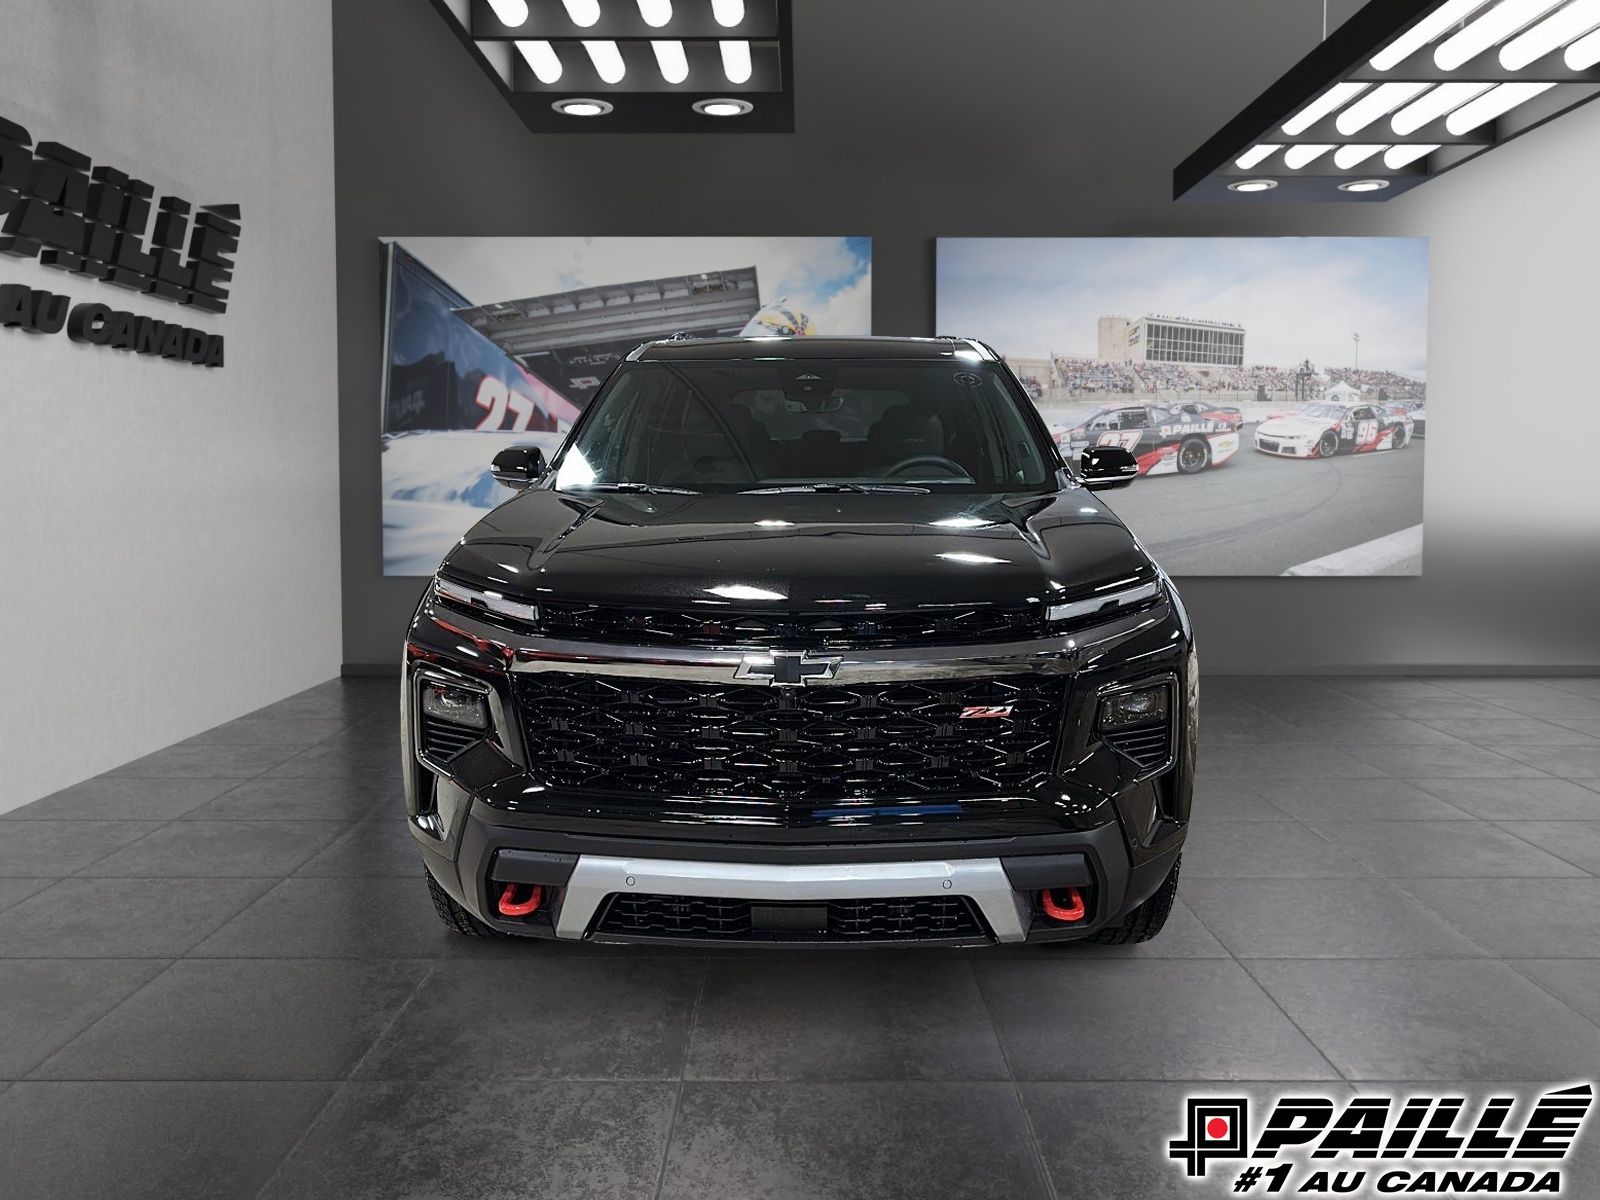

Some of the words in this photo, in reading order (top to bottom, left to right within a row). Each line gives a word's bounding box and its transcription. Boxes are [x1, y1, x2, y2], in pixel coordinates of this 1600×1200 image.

[0, 284, 71, 334] AU
[67, 303, 224, 367] CANADA
[476, 375, 534, 433] 27
[959, 705, 1013, 718] Z71
